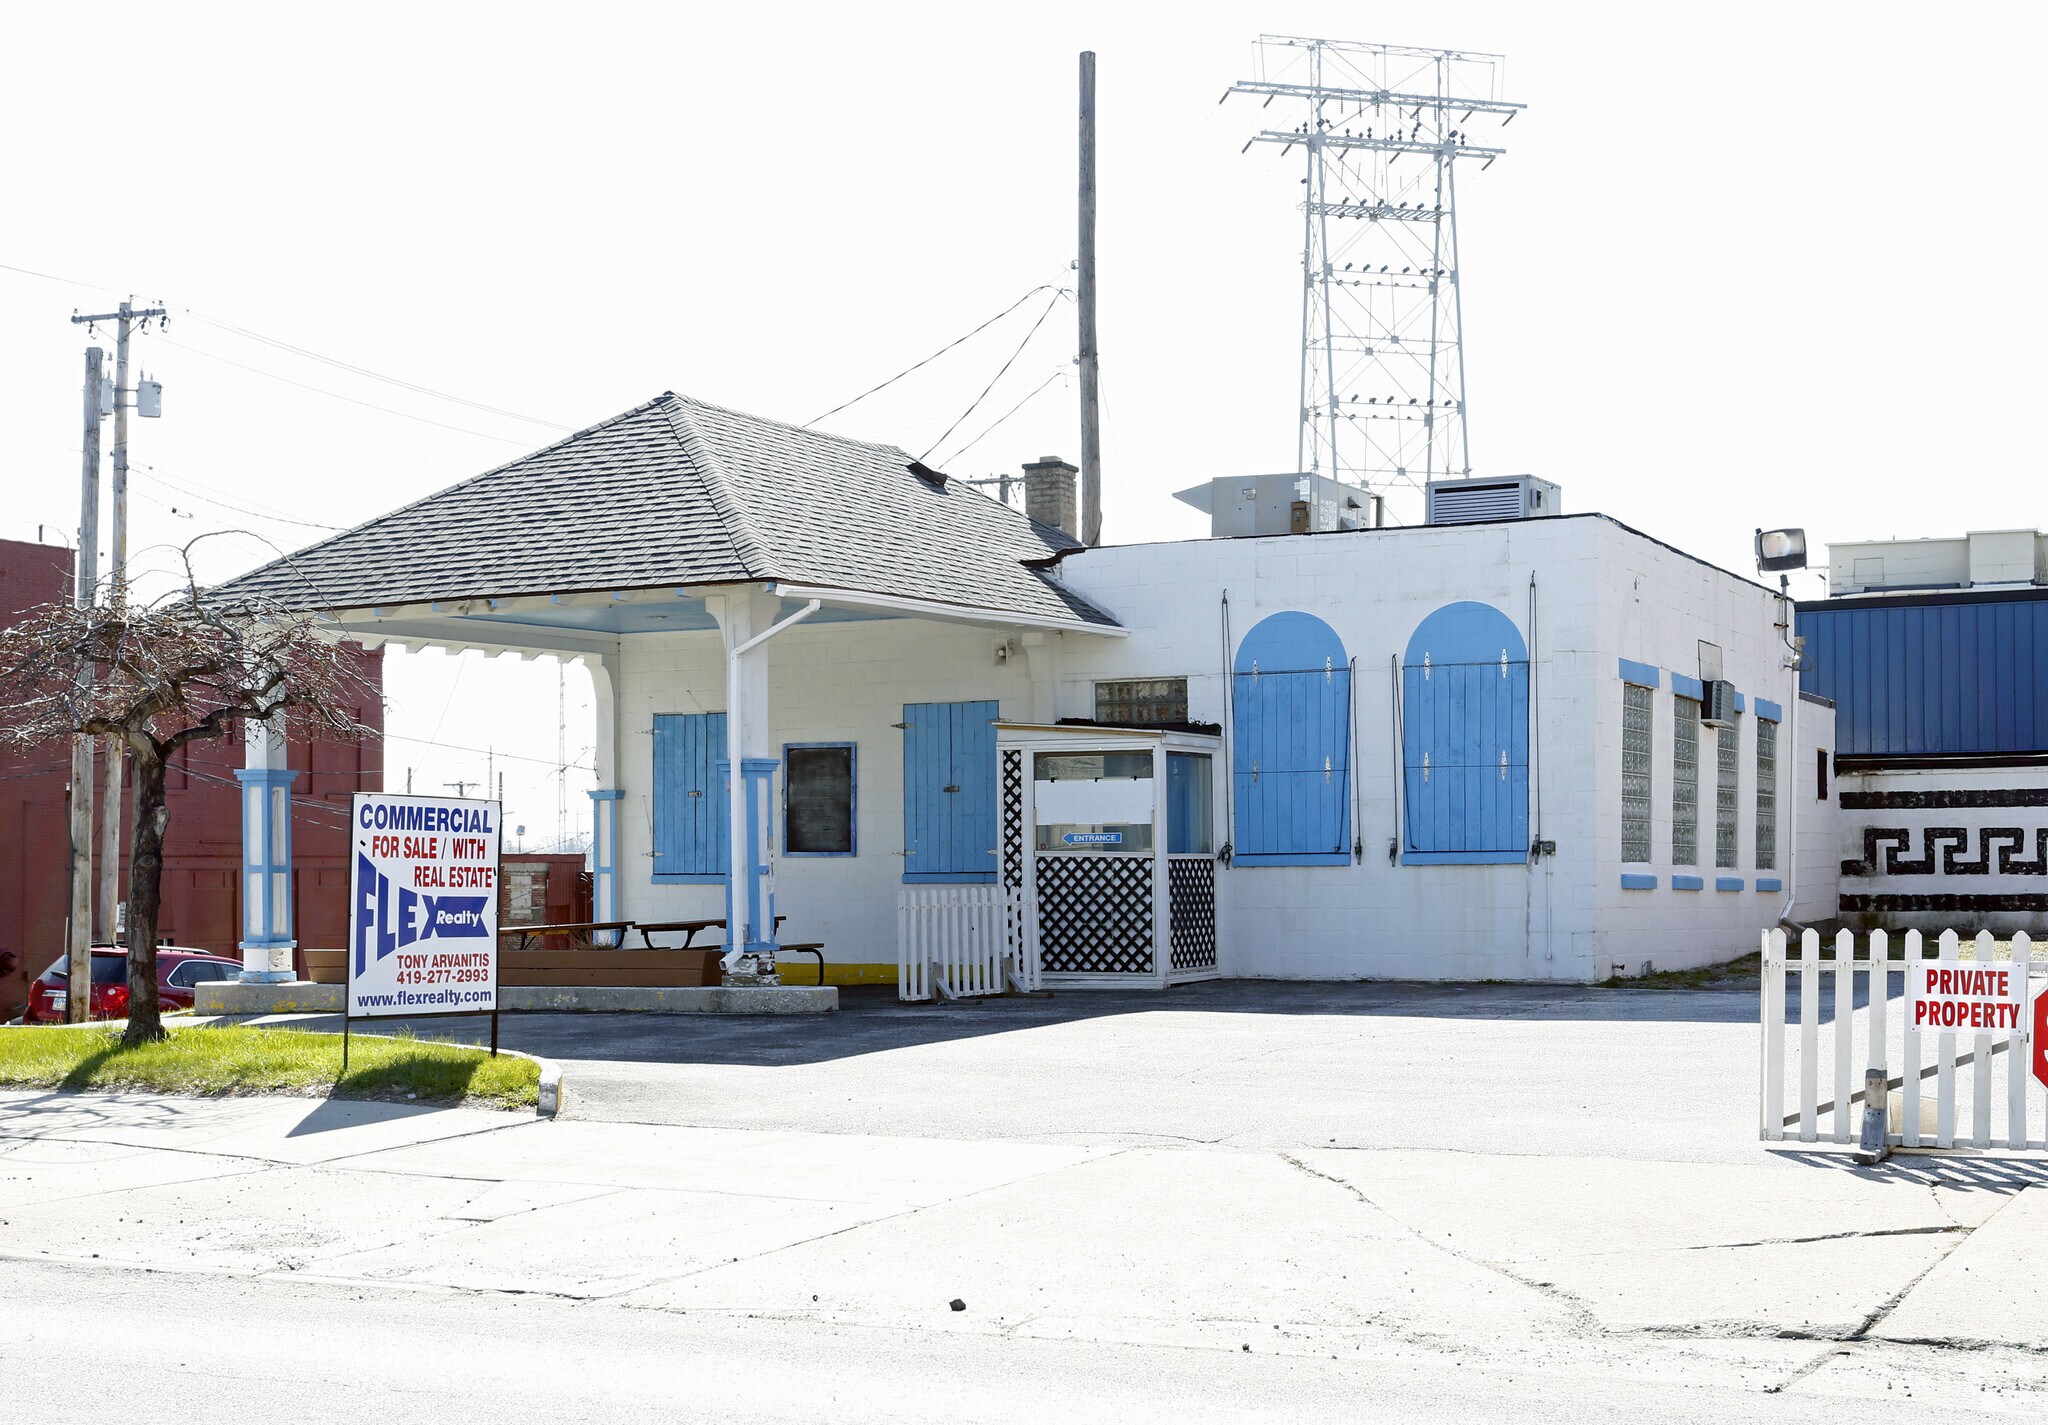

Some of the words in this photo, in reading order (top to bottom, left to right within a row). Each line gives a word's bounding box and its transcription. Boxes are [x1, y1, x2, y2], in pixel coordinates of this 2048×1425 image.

[360, 804, 492, 833] COMMERCIAL
[372, 836, 399, 858] FOR
[404, 837, 437, 859] SALE
[453, 839, 486, 859] WITH
[1073, 834, 1116, 842] ENTRANCE
[414, 866, 445, 887] REAL
[450, 867, 492, 888] ESTATE
[355, 850, 440, 980] FLEX
[436, 910, 480, 927] Realty
[397, 954, 428, 969] TONY
[431, 953, 490, 968] ARVANITIS
[396, 969, 489, 984] 419-277-2993
[1926, 969, 2009, 996] PRIVATE
[357, 989, 492, 1007] www.flexrealty.com
[1915, 1000, 2020, 1029] PROPERTY
